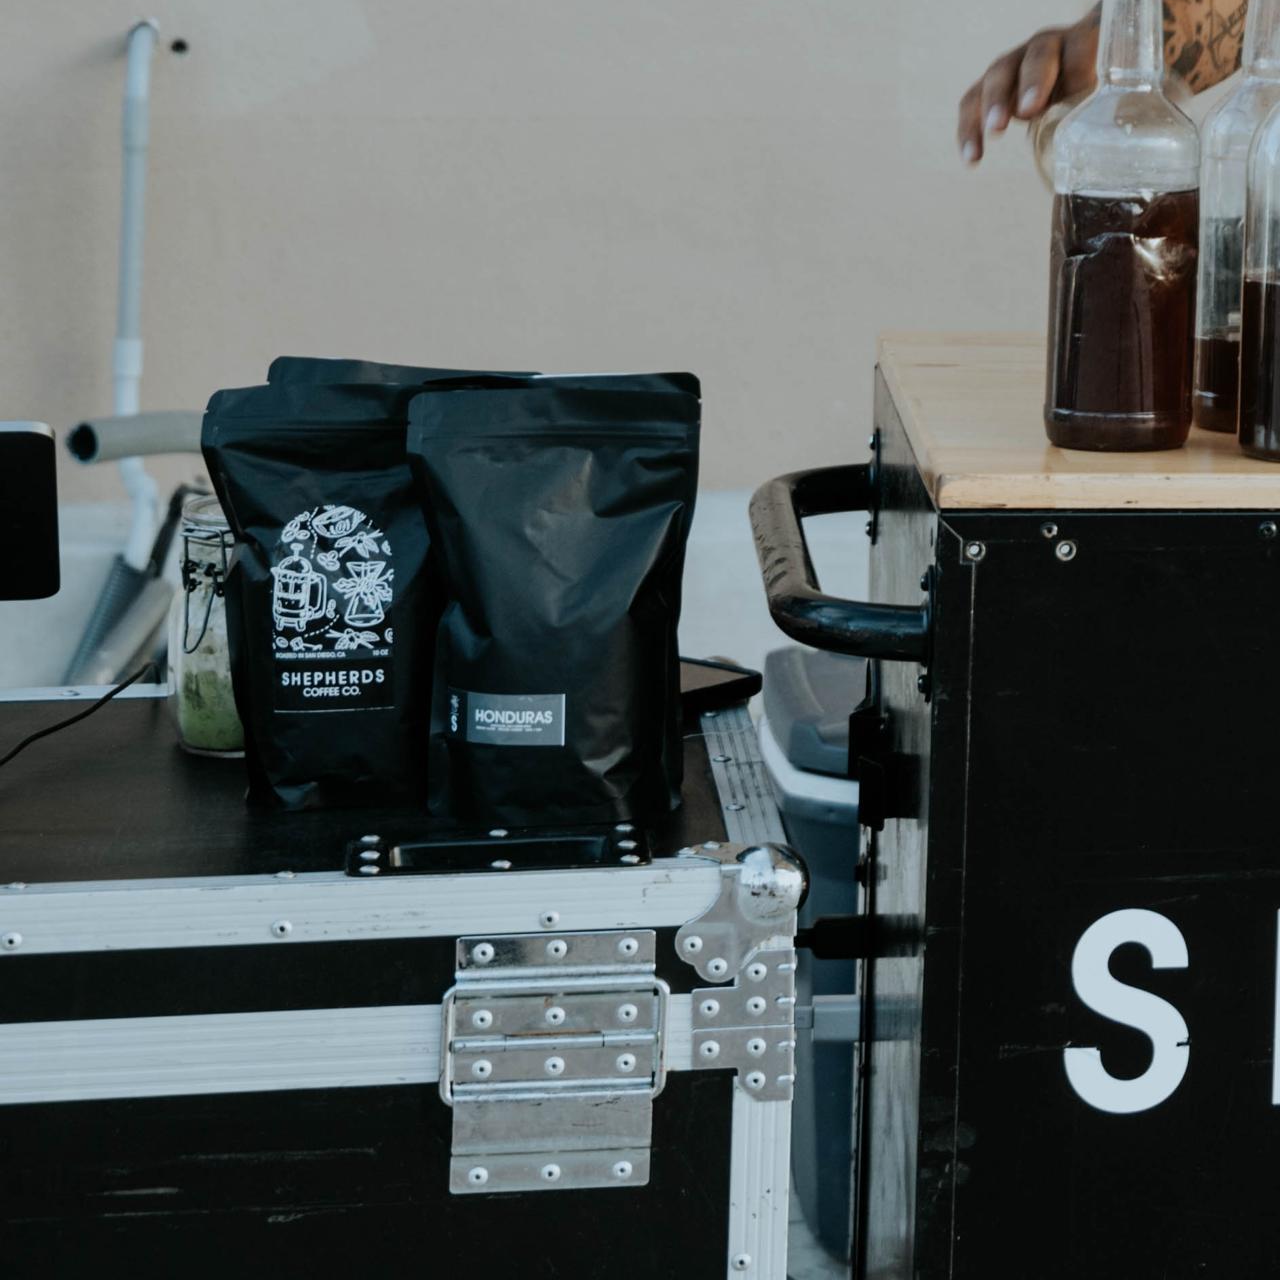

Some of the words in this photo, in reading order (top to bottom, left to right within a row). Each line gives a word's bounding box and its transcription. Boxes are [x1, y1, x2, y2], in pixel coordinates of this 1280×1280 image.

[282, 669, 385, 686] SHEPHERDS
[303, 687, 339, 697] COFFEE
[342, 686, 361, 695] CO.
[475, 708, 553, 724] HONDURAS
